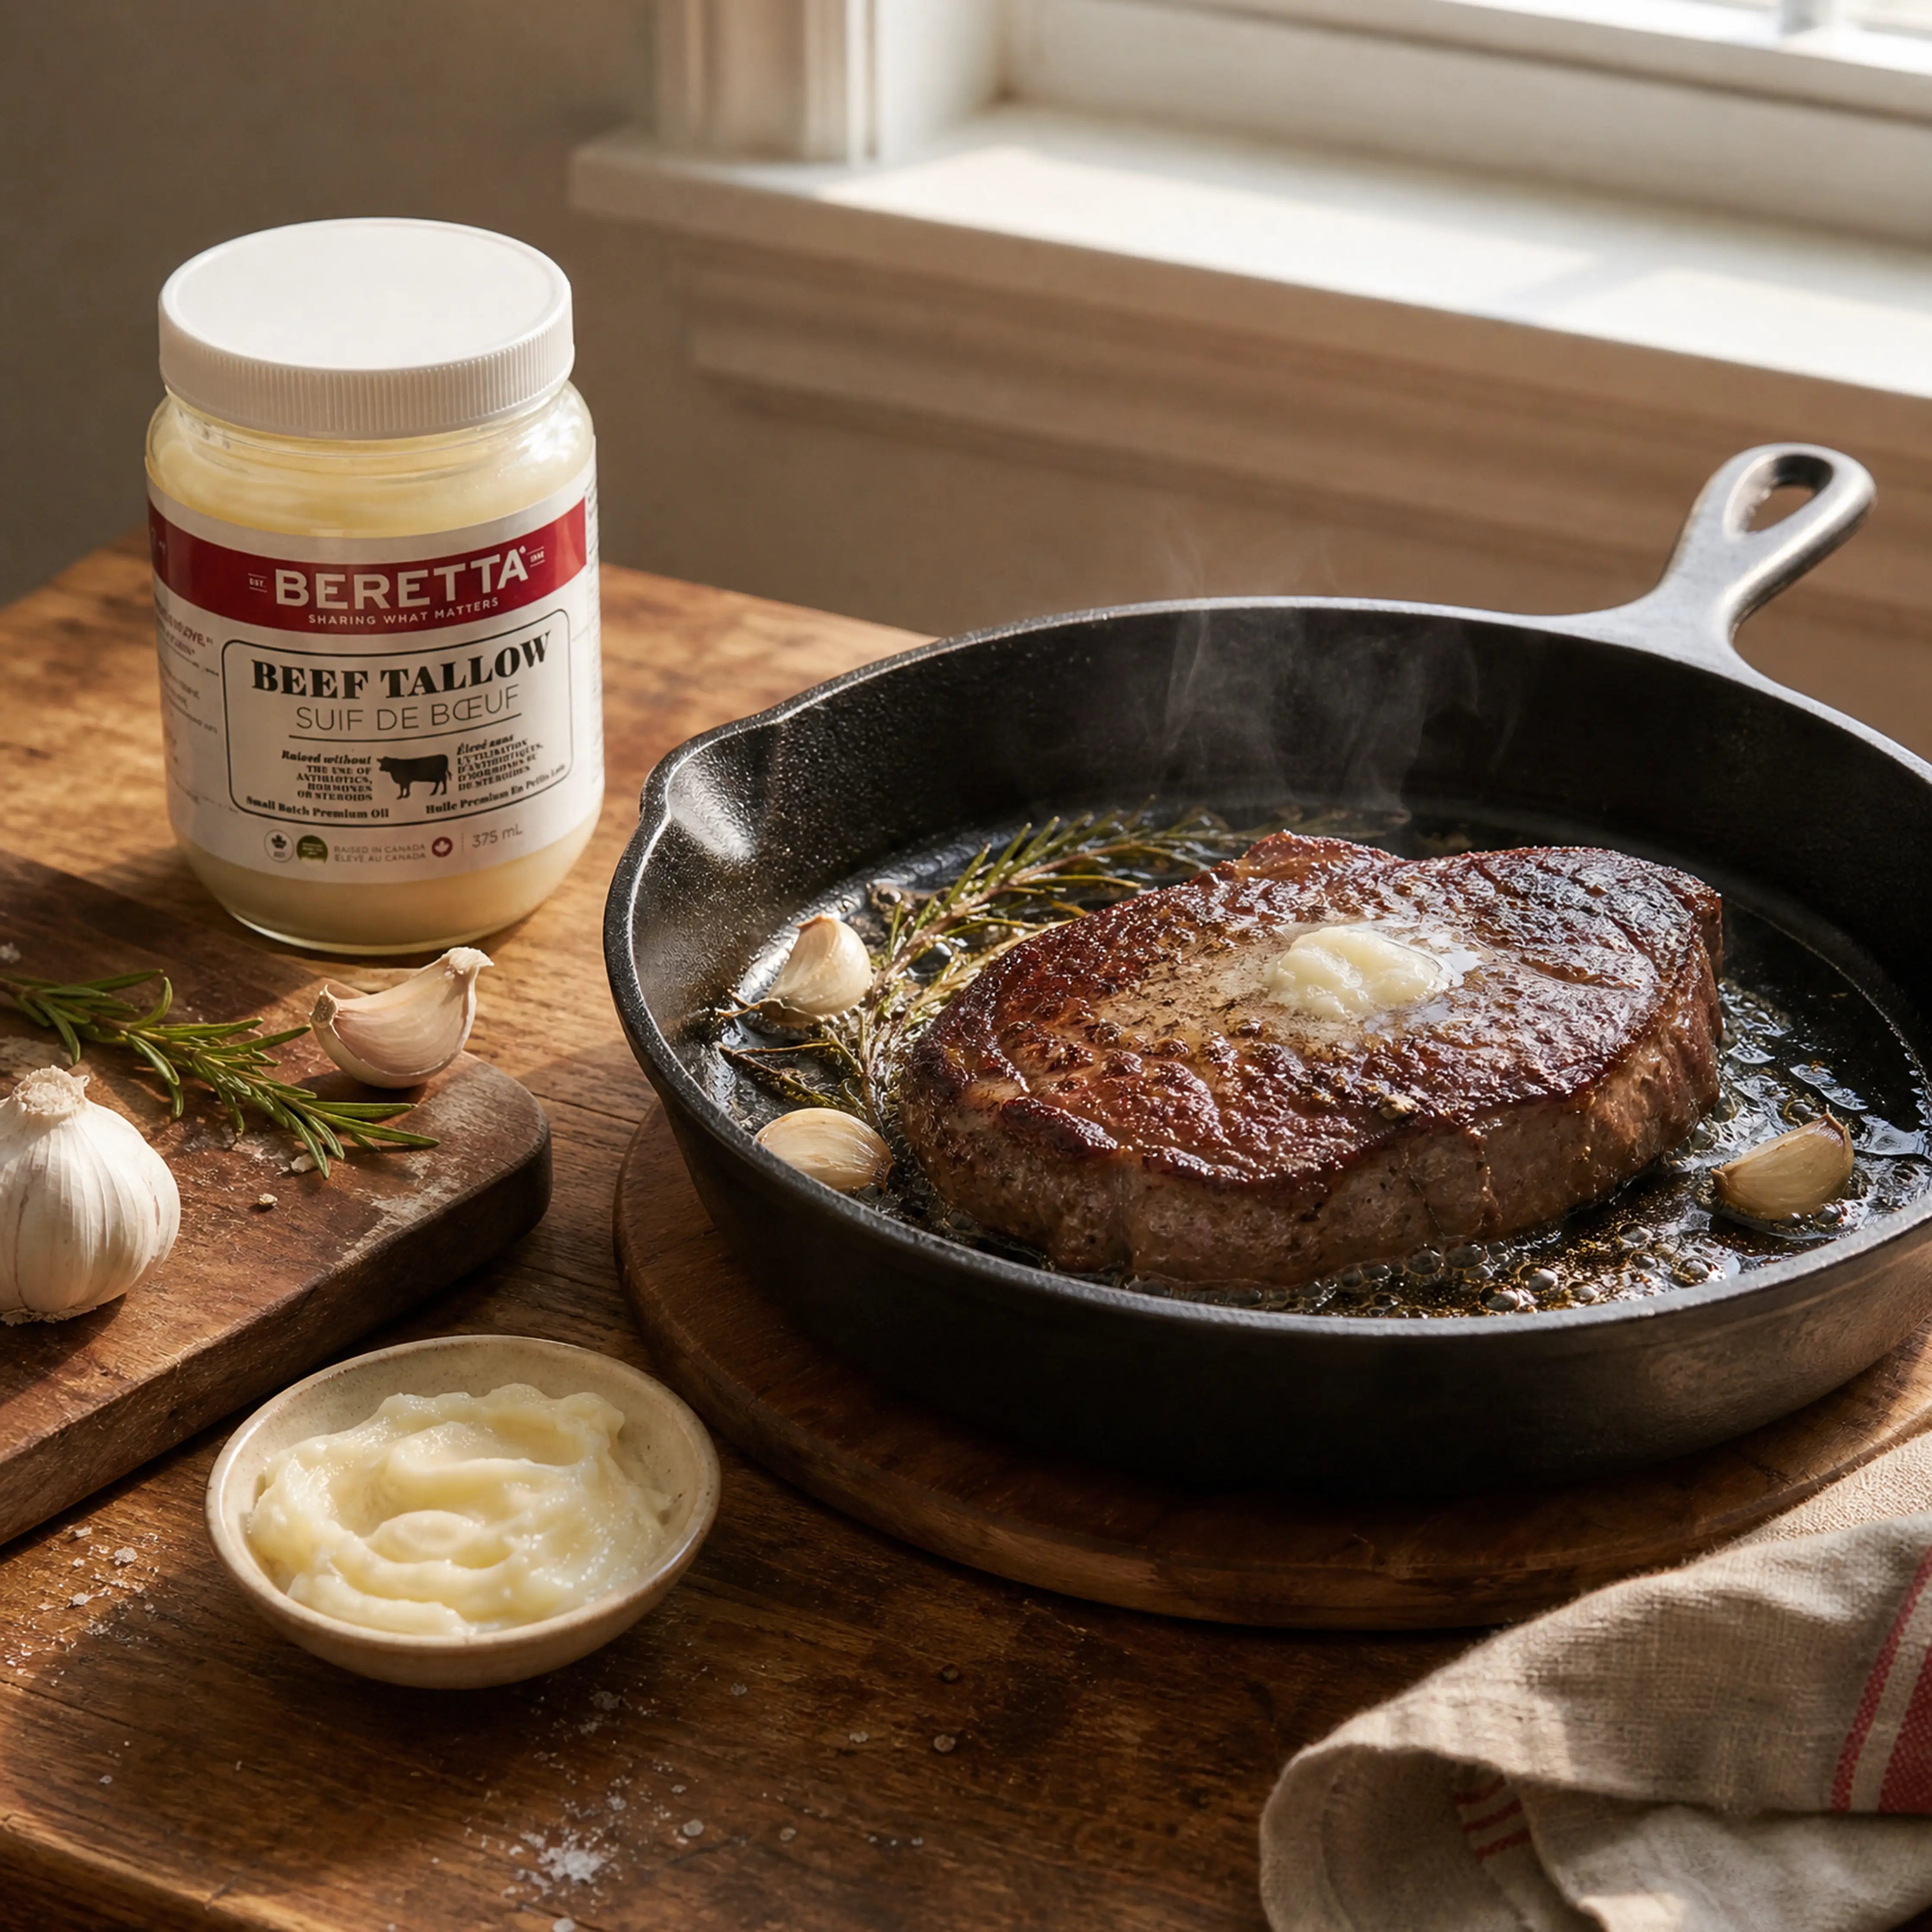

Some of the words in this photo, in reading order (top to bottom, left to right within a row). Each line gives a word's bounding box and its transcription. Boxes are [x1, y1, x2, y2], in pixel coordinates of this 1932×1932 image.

[275, 548, 529, 609] BERETTA
[309, 614, 376, 625] SHARING
[383, 612, 428, 624] WHAT
[435, 597, 498, 619] MATTERS
[251, 659, 369, 699] BEEF
[380, 630, 551, 698] TALLOW
[296, 707, 363, 731] SUIF
[377, 707, 419, 730] DE
[431, 684, 519, 725] BŒUF
[282, 750, 321, 763] Raised
[324, 755, 371, 765] without
[307, 765, 328, 774] THE
[308, 783, 373, 792] HORMONES
[315, 792, 373, 801] STEROIDS
[246, 795, 275, 810] Small
[278, 802, 309, 816] Batch
[312, 807, 367, 818] Premium
[371, 808, 389, 818] Oil
[472, 830, 498, 848] 375
[502, 823, 523, 840] mL
[384, 844, 425, 853] CANADA
[385, 853, 426, 861] CANADA
